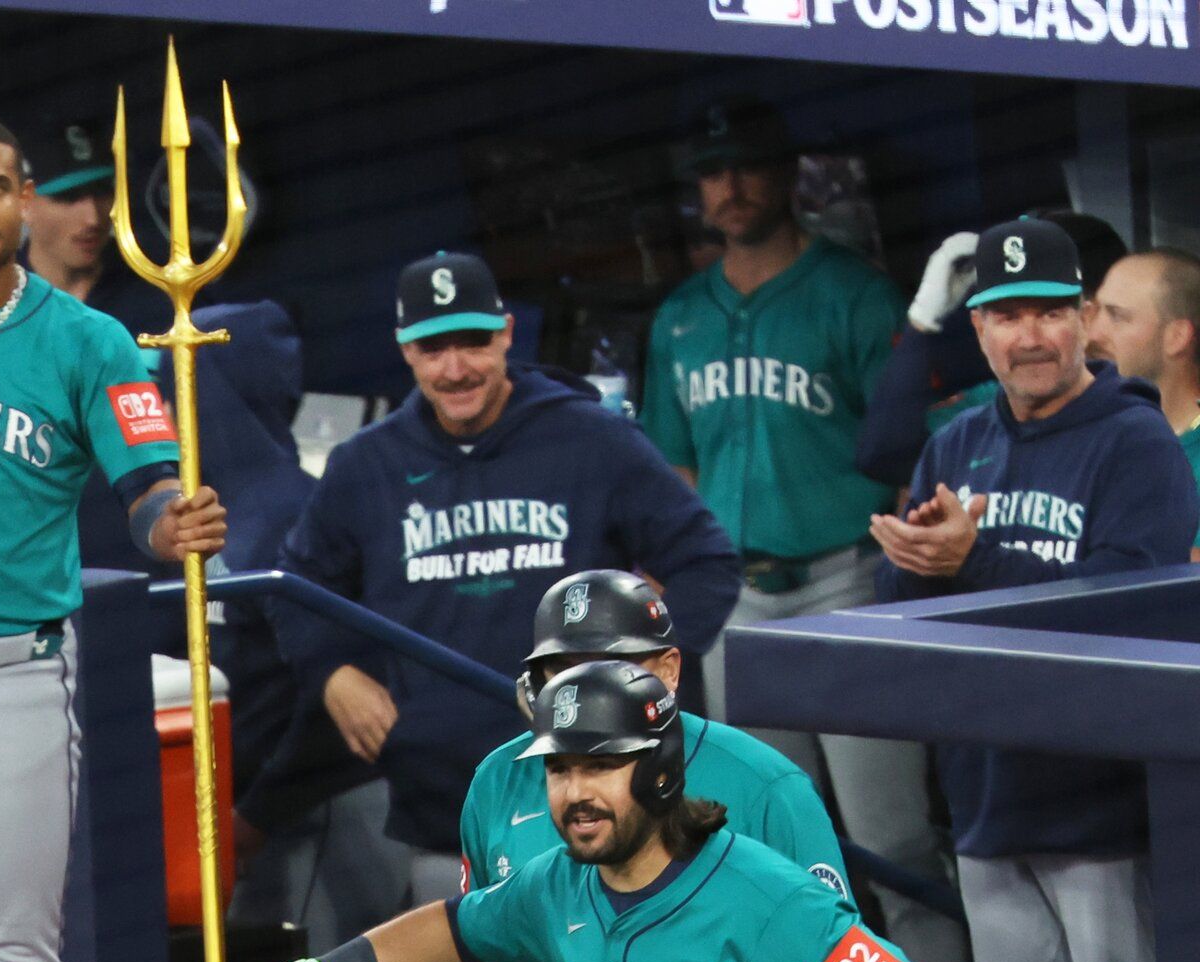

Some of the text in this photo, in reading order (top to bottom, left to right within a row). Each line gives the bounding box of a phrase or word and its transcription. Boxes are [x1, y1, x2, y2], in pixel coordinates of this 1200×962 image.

[814, 0, 1189, 49] SEASON
[1003, 236, 1026, 273] S
[431, 268, 456, 305] S
[140, 391, 163, 416] 2
[401, 500, 568, 558] MARINERS
[962, 490, 1084, 540] RINERS
[406, 541, 565, 583] BUILT FOR FALL
